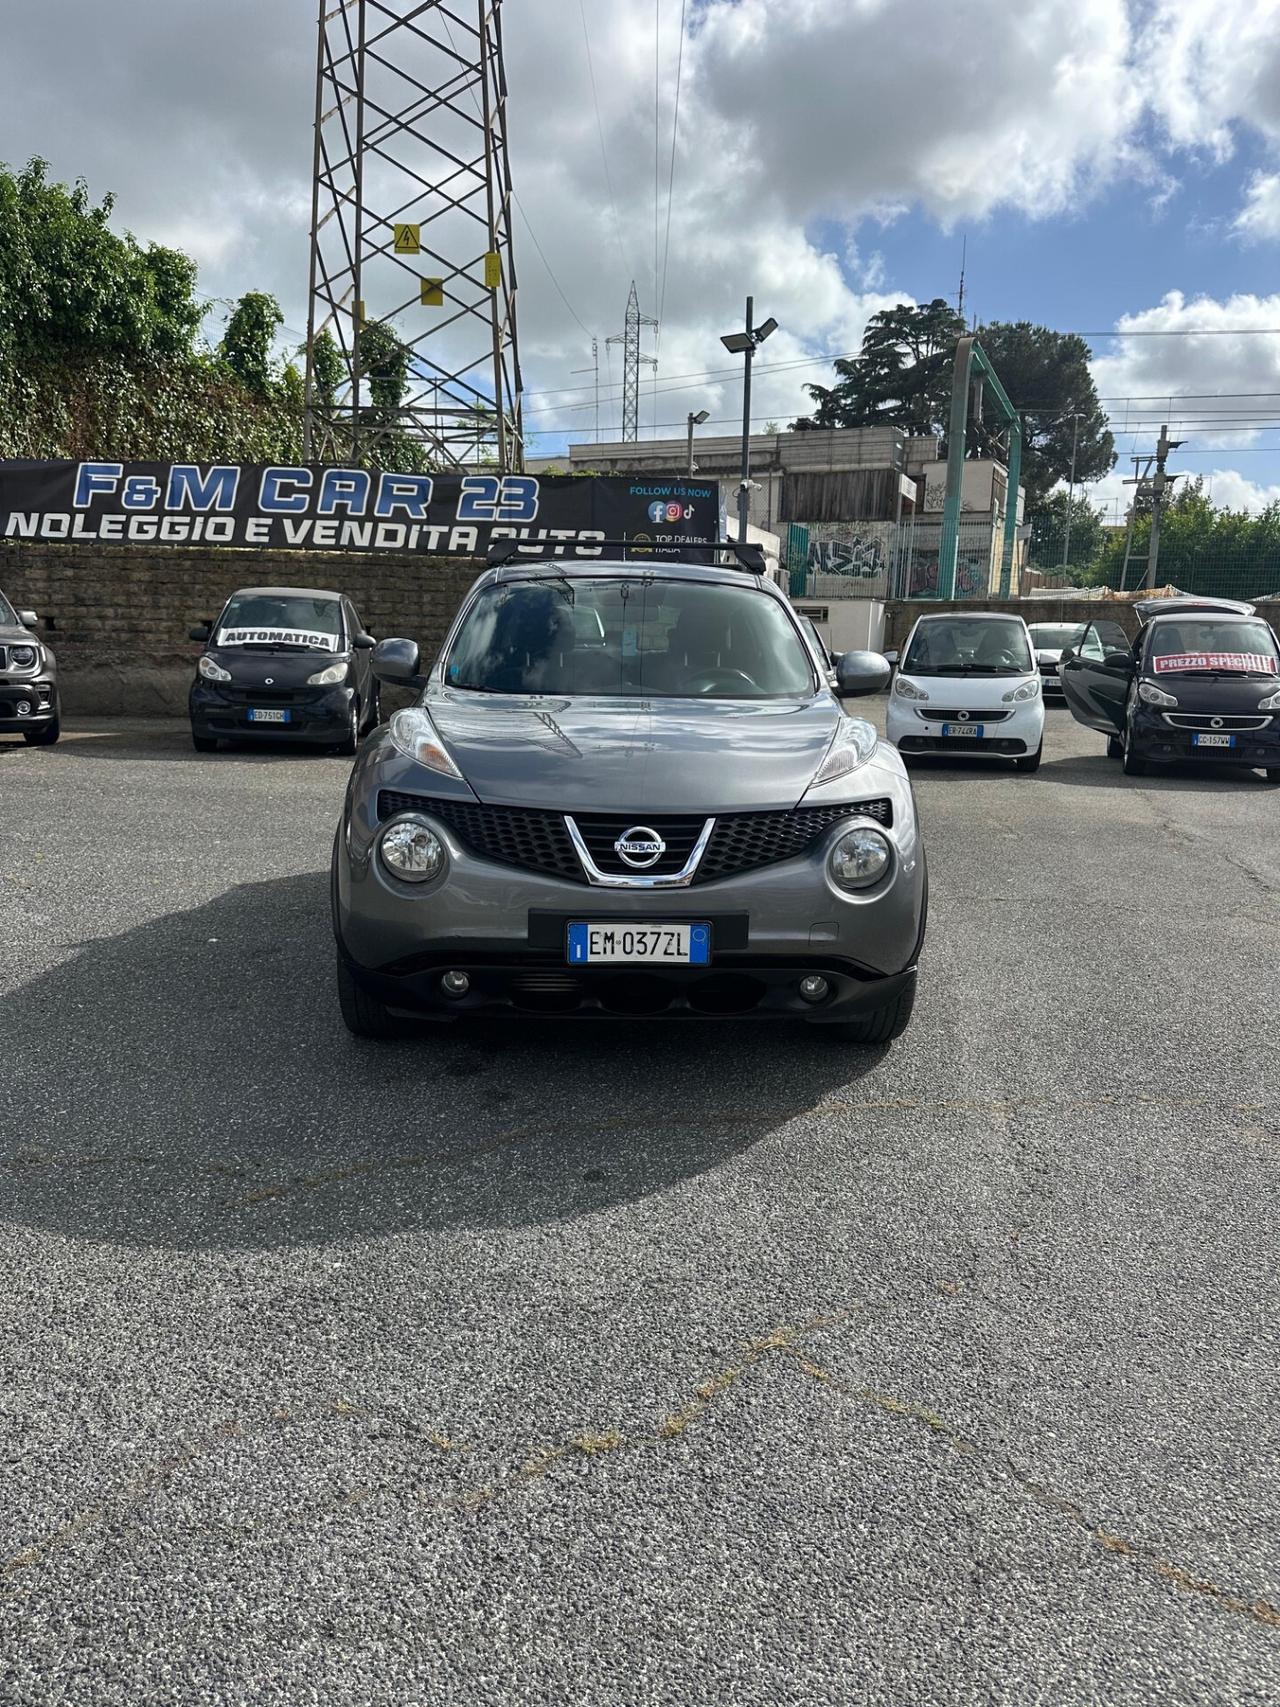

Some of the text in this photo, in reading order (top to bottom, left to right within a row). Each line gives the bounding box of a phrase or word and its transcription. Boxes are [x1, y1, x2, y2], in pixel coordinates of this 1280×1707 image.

[73, 462, 539, 522] F&M CAR 23
[629, 486, 712, 498] FOLLOW US NOW
[4, 511, 236, 542] NOLEGGIO
[245, 517, 273, 542] E
[282, 518, 479, 551] VENDITA
[225, 632, 330, 646] AUTOMATICA
[1160, 656, 1207, 669] PREZZO
[619, 843, 661, 851] NISSAN
